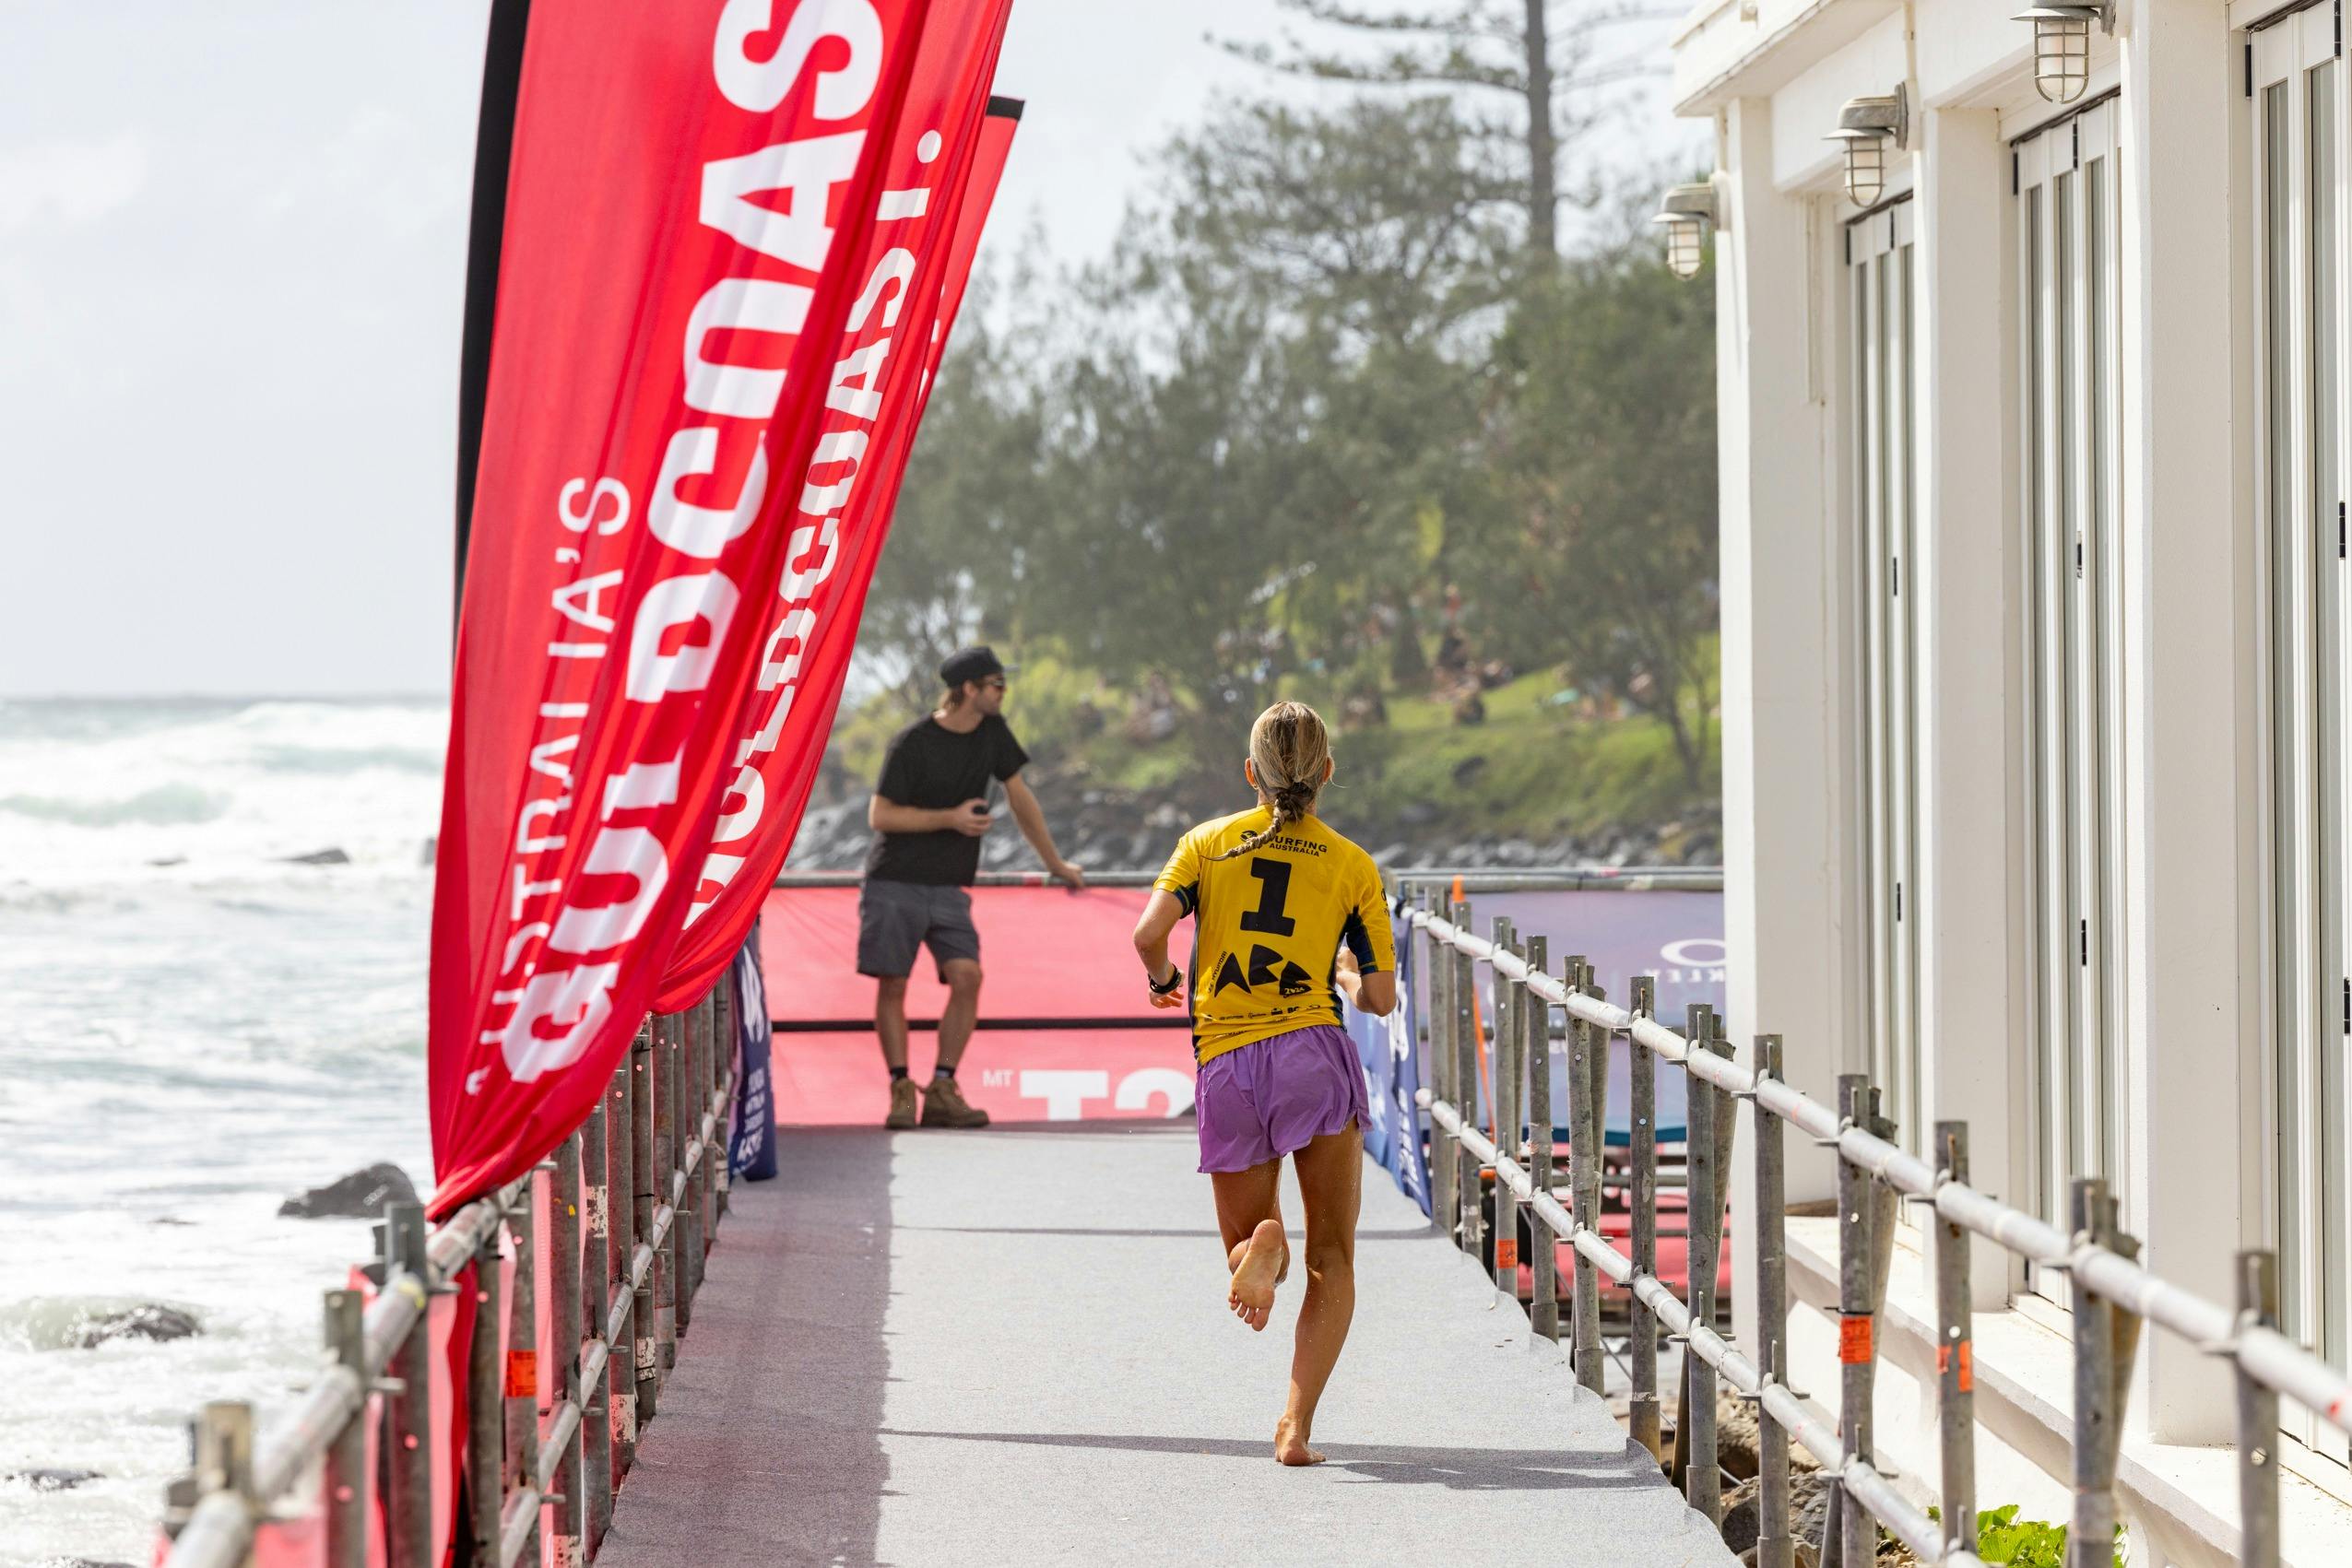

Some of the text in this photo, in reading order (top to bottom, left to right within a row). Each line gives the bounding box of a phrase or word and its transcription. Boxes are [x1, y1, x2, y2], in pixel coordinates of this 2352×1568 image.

[1270, 843, 1320, 857] AUSTRALIA
[1274, 835, 1328, 853] URFING
[1240, 856, 1295, 937] 1
